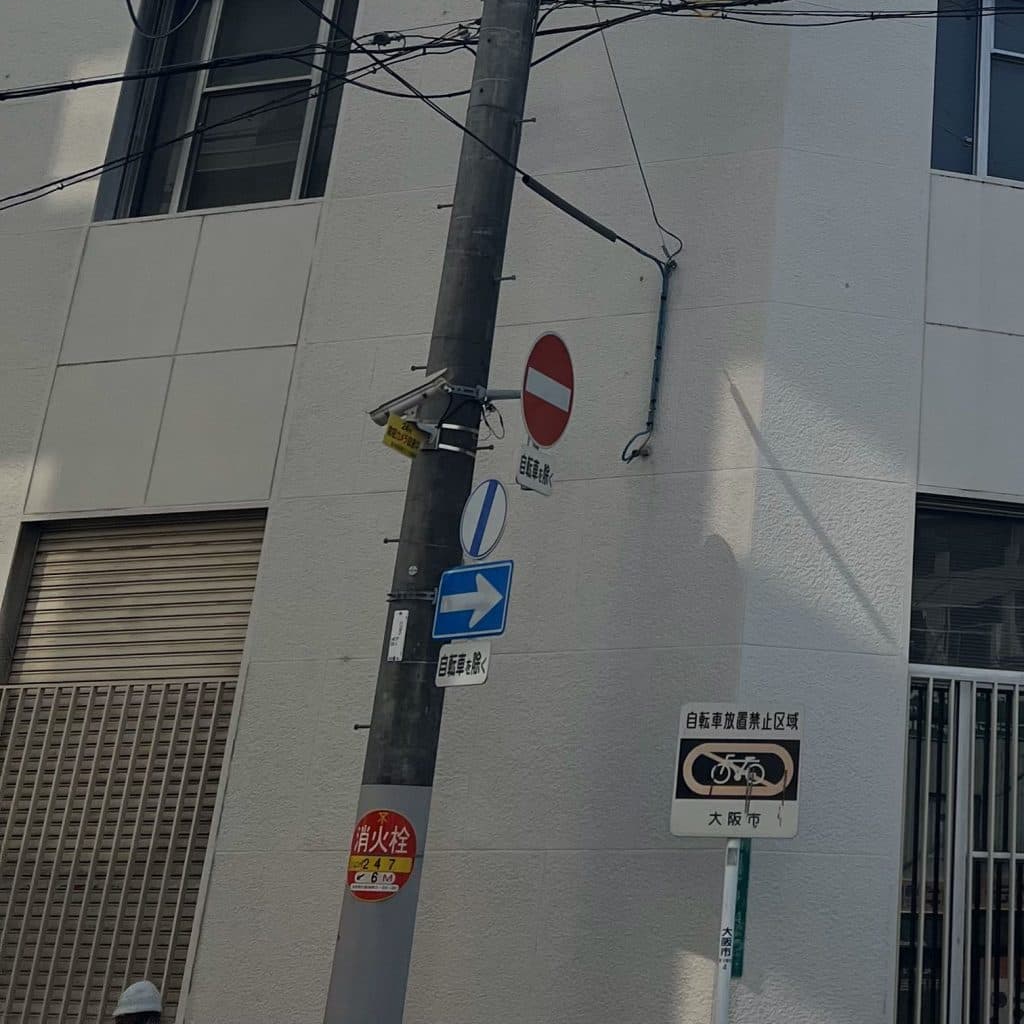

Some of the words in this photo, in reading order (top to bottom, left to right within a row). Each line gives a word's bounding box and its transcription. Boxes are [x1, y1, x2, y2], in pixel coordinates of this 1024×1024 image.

[686, 711, 799, 730] 自転車放置禁止区域
[708, 811, 761, 829] 大阪市
[354, 824, 410, 854] 消火栓
[720, 926, 733, 957] 大阪市
